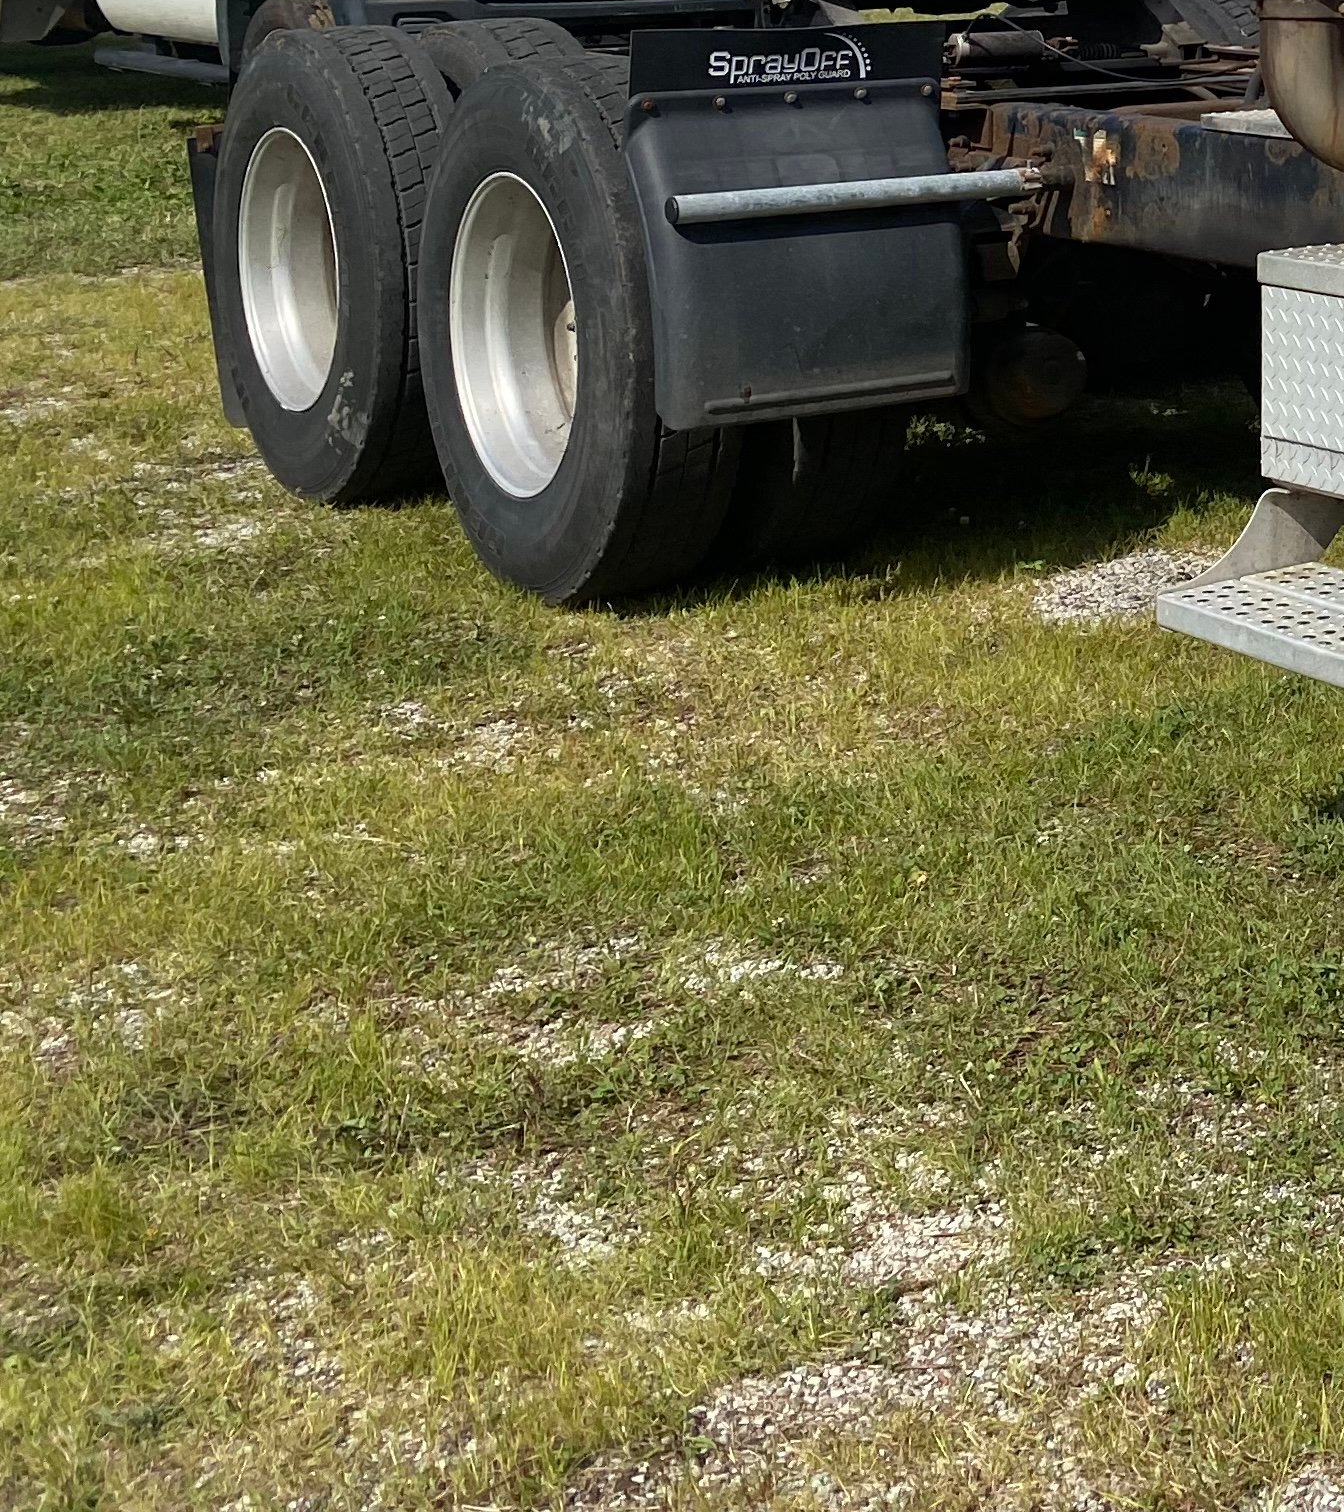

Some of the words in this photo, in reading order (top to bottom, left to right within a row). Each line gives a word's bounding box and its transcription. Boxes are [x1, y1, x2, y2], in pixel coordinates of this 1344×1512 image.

[737, 74, 792, 84] ANTI-SPRAY
[793, 71, 818, 81] POLY
[818, 69, 851, 79] GUARD
